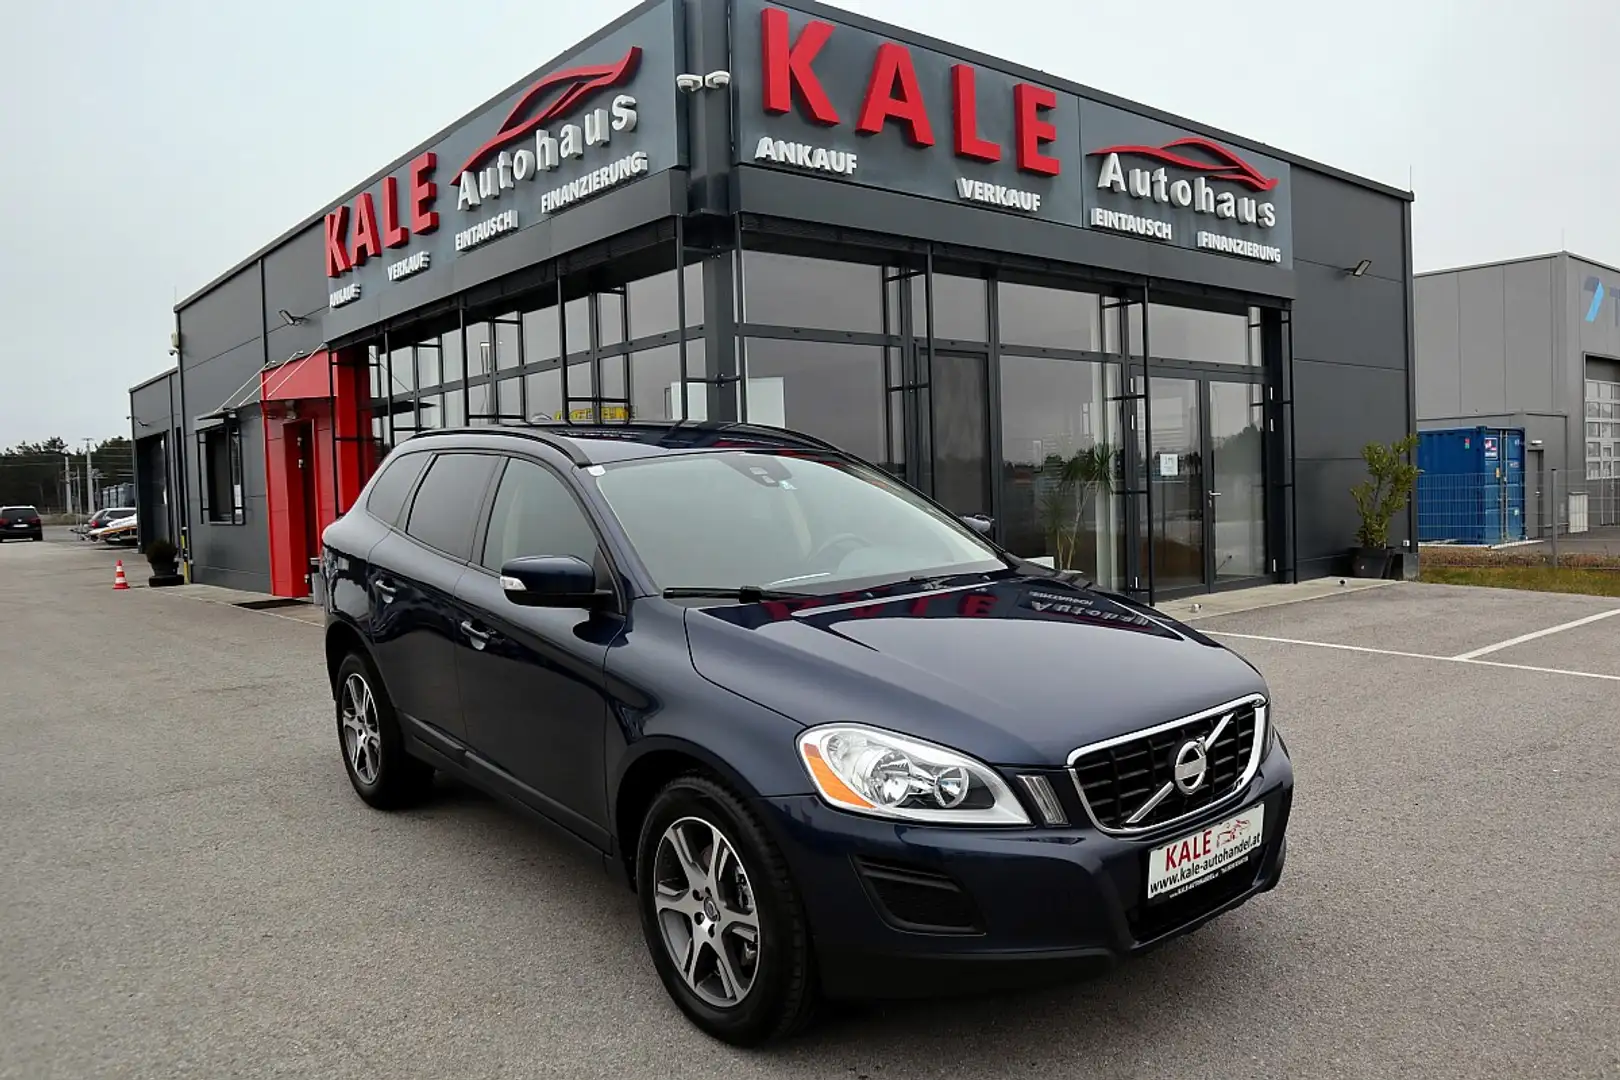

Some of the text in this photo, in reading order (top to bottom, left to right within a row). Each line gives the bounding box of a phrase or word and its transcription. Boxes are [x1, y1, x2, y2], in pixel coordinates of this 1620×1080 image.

[761, 7, 1060, 176] KALE
[457, 95, 637, 211] Autohaus
[754, 136, 858, 174] ANKAUF
[541, 151, 648, 213] FINANZIERUNG
[956, 177, 1042, 212] VERKAUF
[1097, 152, 1276, 228] Autohaus
[324, 152, 439, 278] KALE
[455, 210, 519, 251] EINTAUSCH
[1090, 207, 1173, 240] EINTAUSCH
[387, 250, 431, 281] VERKAUF
[1197, 230, 1282, 263] FINANZIERUNG
[1150, 832, 1261, 893] www.kale-autohandel.at
[1165, 830, 1213, 872] KALE
